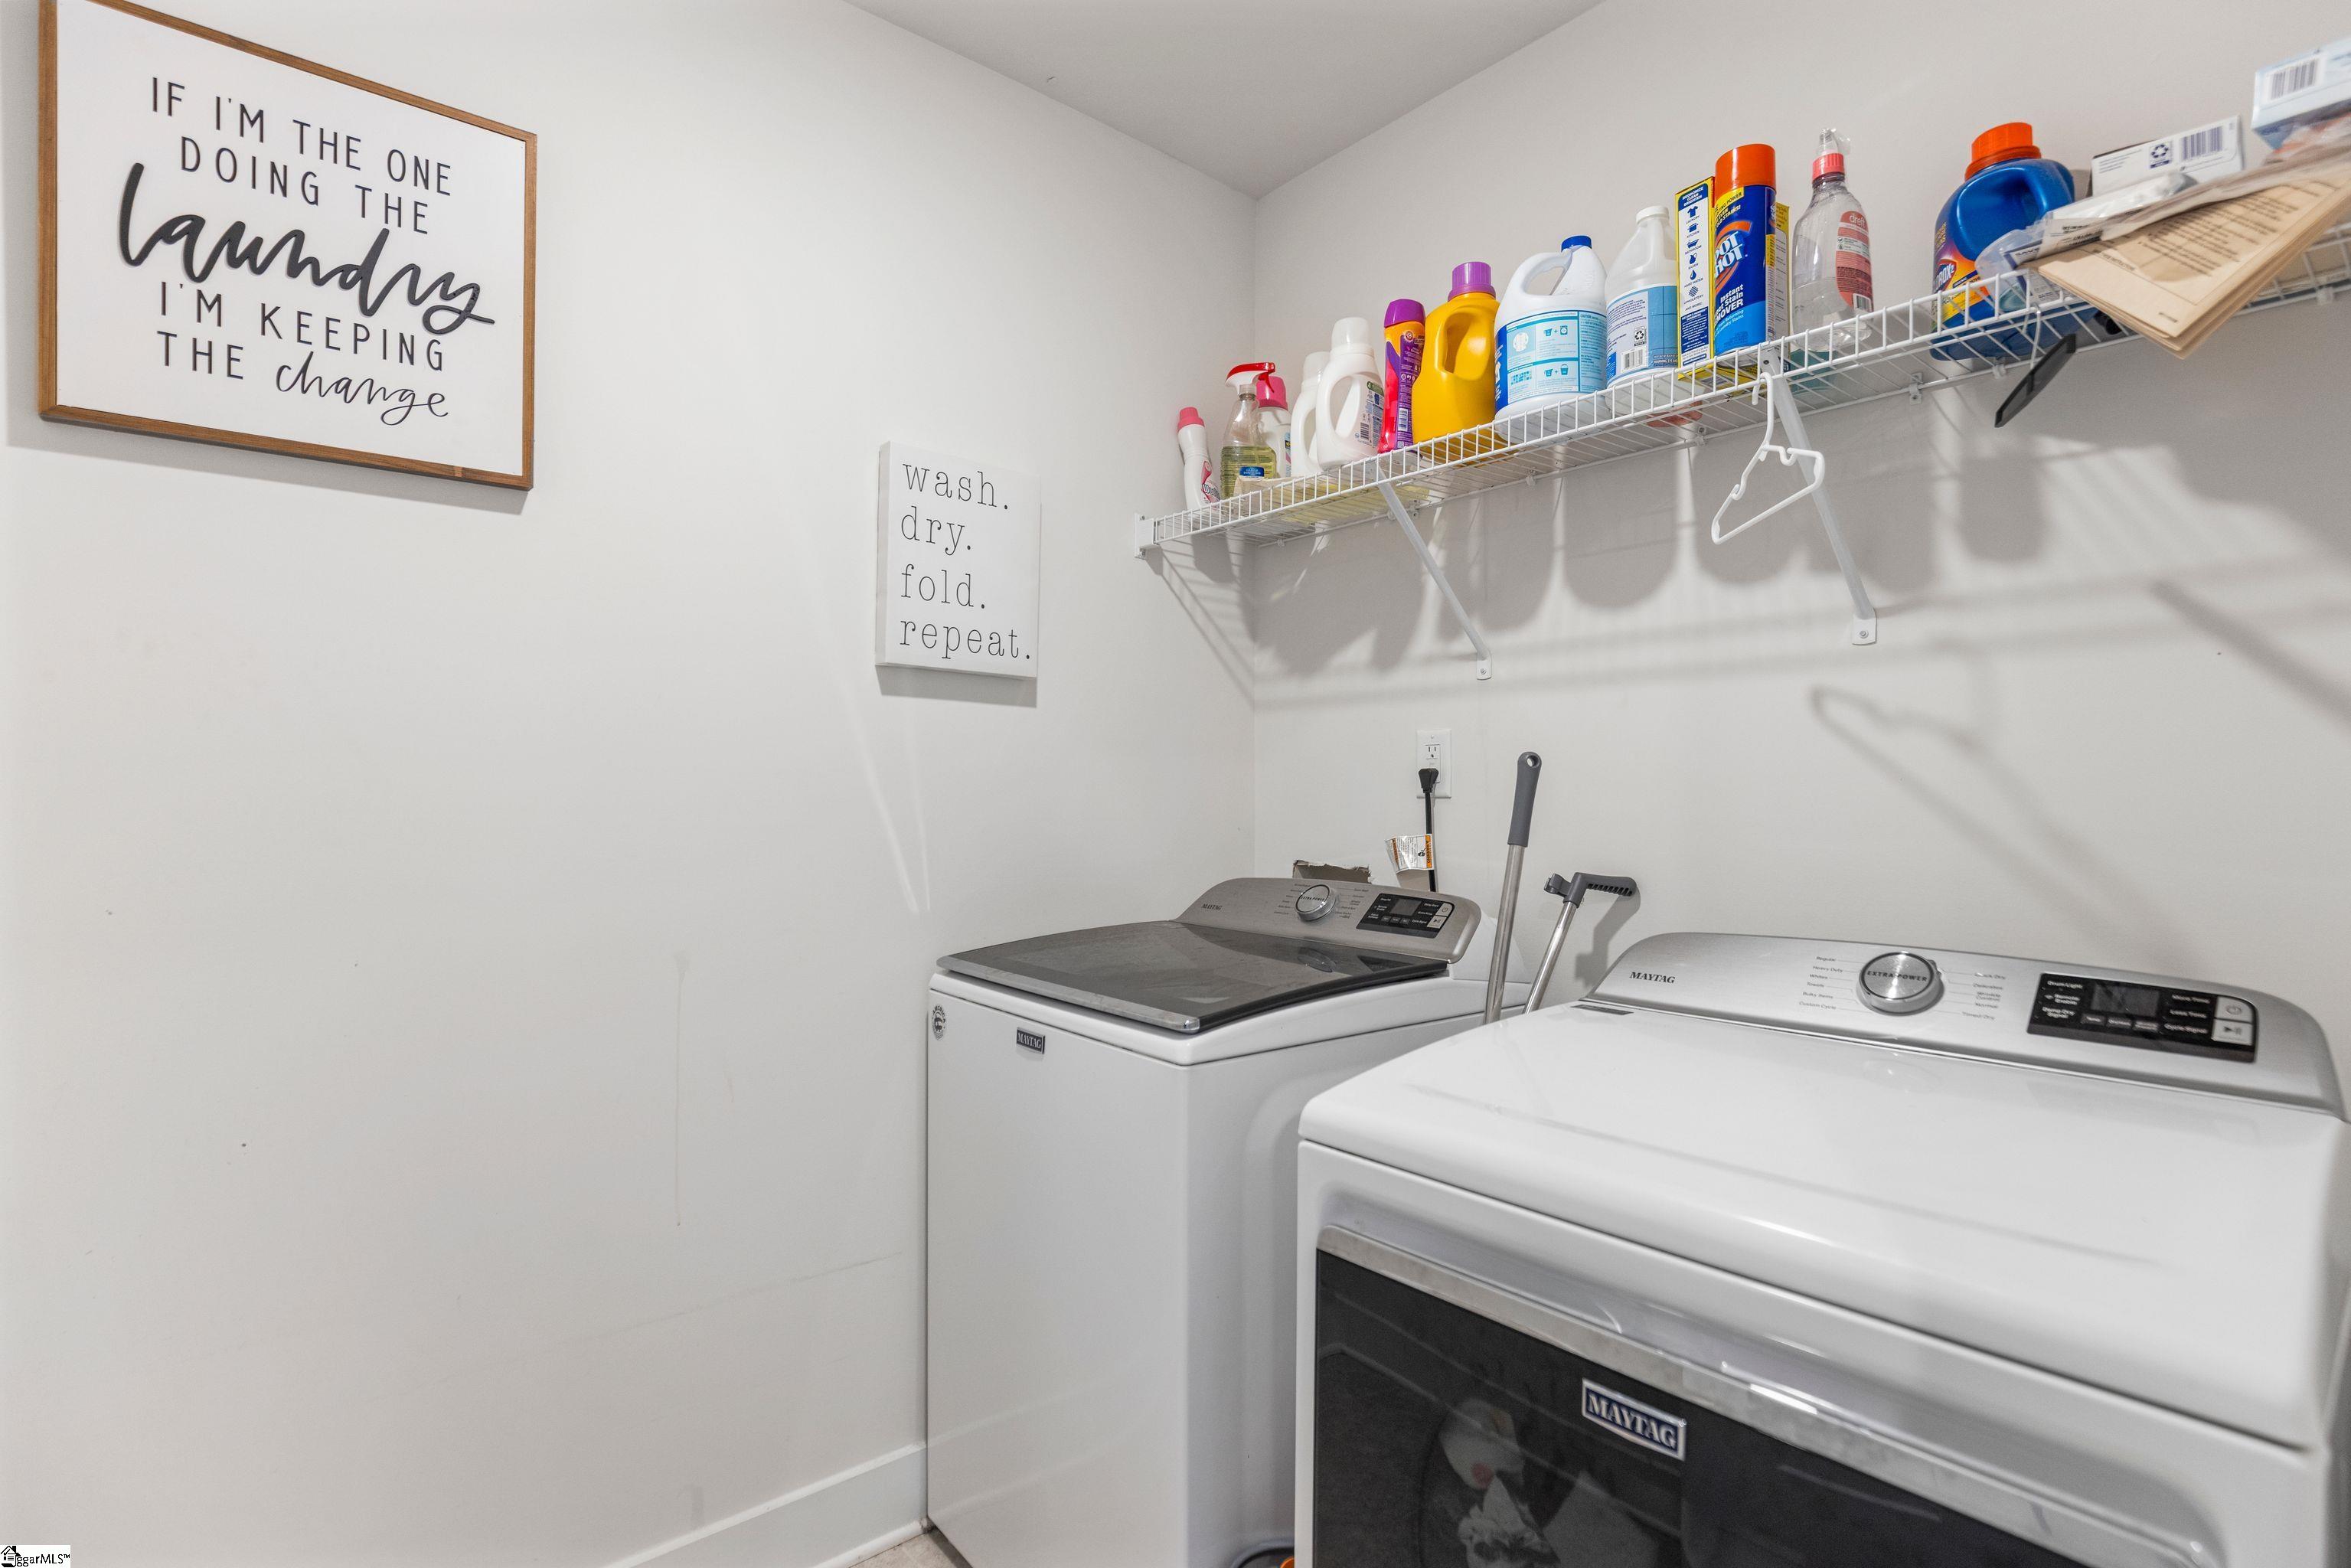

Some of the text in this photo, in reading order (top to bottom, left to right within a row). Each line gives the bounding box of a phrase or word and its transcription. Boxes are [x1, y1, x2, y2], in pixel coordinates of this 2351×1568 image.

[152, 77, 451, 196] IF I'M THE ONE
[181, 136, 428, 234] DOING THE
[119, 163, 495, 335] laundry
[1720, 284, 1744, 304] Instant
[1724, 291, 1744, 307] Stain
[161, 281, 442, 371] I'M KEEPING
[157, 331, 449, 426] THE change
[903, 464, 1009, 510] wash.
[901, 506, 971, 555] dry.
[901, 564, 985, 609] fold.
[900, 620, 1030, 659] repeat.
[1629, 972, 1675, 984] MAYTAG
[1897, 974, 1928, 982] POWER
[1017, 1032, 1042, 1049] MAYTAG
[1589, 1393, 1677, 1449] MAYTAG
